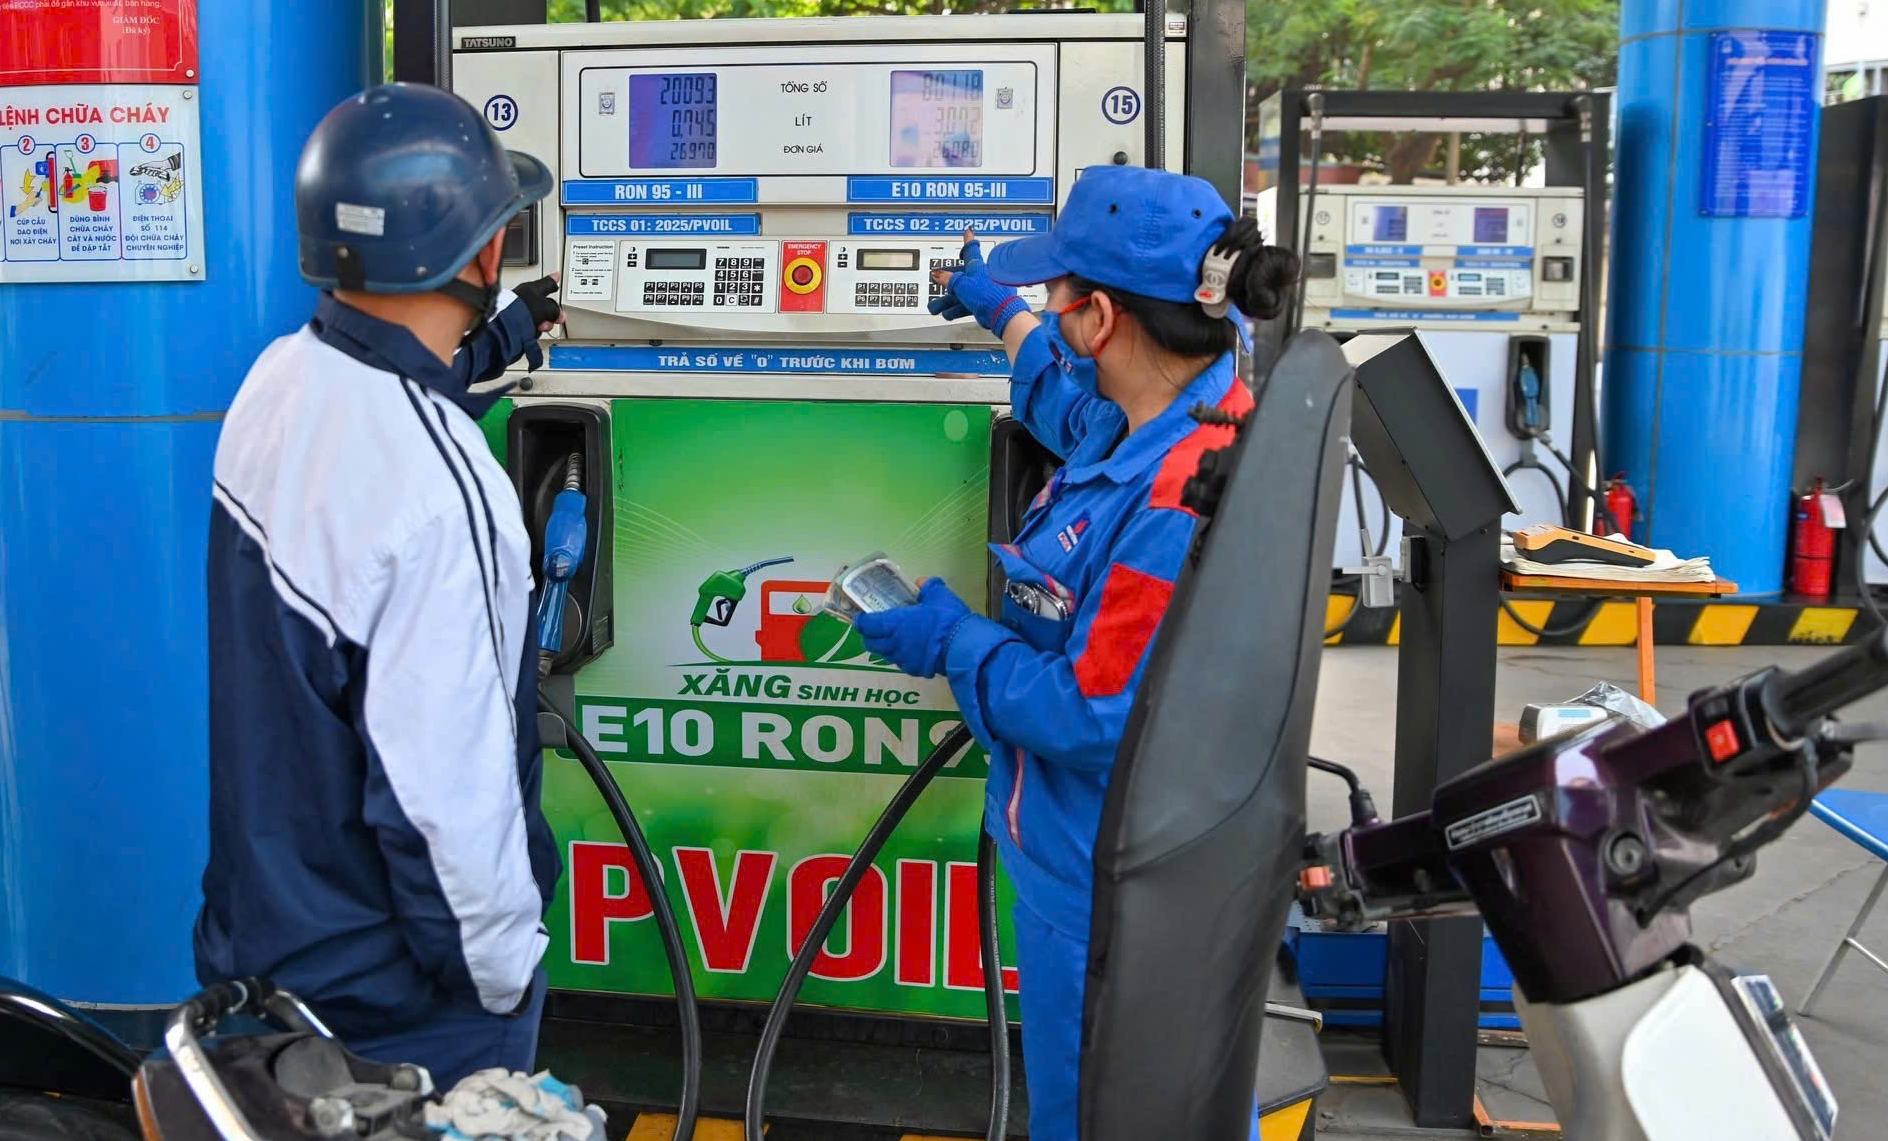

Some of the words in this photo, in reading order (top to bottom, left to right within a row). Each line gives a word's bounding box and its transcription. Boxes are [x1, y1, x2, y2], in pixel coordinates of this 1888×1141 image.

[14, 1, 34, 9] PCCC
[140, 15, 160, 24] ĐỐC
[464, 38, 514, 48] TATSUNO
[661, 76, 717, 104] 20093
[781, 81, 809, 93] TỔNG
[813, 81, 828, 93] SỐ
[1111, 94, 1133, 114] 15
[46, 104, 103, 124] CHỮA
[110, 103, 170, 124] CHÁY
[492, 102, 512, 121] 13
[795, 113, 812, 126] LÍT
[23, 138, 31, 151] 2
[82, 137, 90, 150] 3
[145, 136, 154, 149] 4
[784, 145, 804, 153] ĐƠN
[806, 143, 823, 153] GIÁ
[615, 185, 647, 199] RON
[652, 185, 671, 199] 95
[686, 184, 702, 199] III
[892, 183, 921, 197] E10
[926, 182, 959, 197] RON
[964, 182, 1007, 198] 95-III
[140, 223, 151, 231] SỐ
[592, 219, 626, 231] TCCS
[630, 219, 651, 231] 01:
[655, 219, 733, 231] 2025/PVOIL
[864, 219, 905, 231] TCCS
[910, 219, 930, 231] 02
[944, 218, 1036, 231] 2025/PVOIL
[728, 296, 735, 304] C
[658, 351, 690, 367] TRẢ
[695, 353, 718, 367] SỐ
[780, 355, 836, 369] TRƯỚC
[841, 358, 870, 369] KHI
[875, 358, 915, 370] BƠM
[678, 668, 791, 697] XĂNG
[798, 685, 858, 702] SINH
[864, 688, 921, 707] HỌC
[582, 704, 714, 757] E10
[569, 841, 1019, 994] PVOIL
